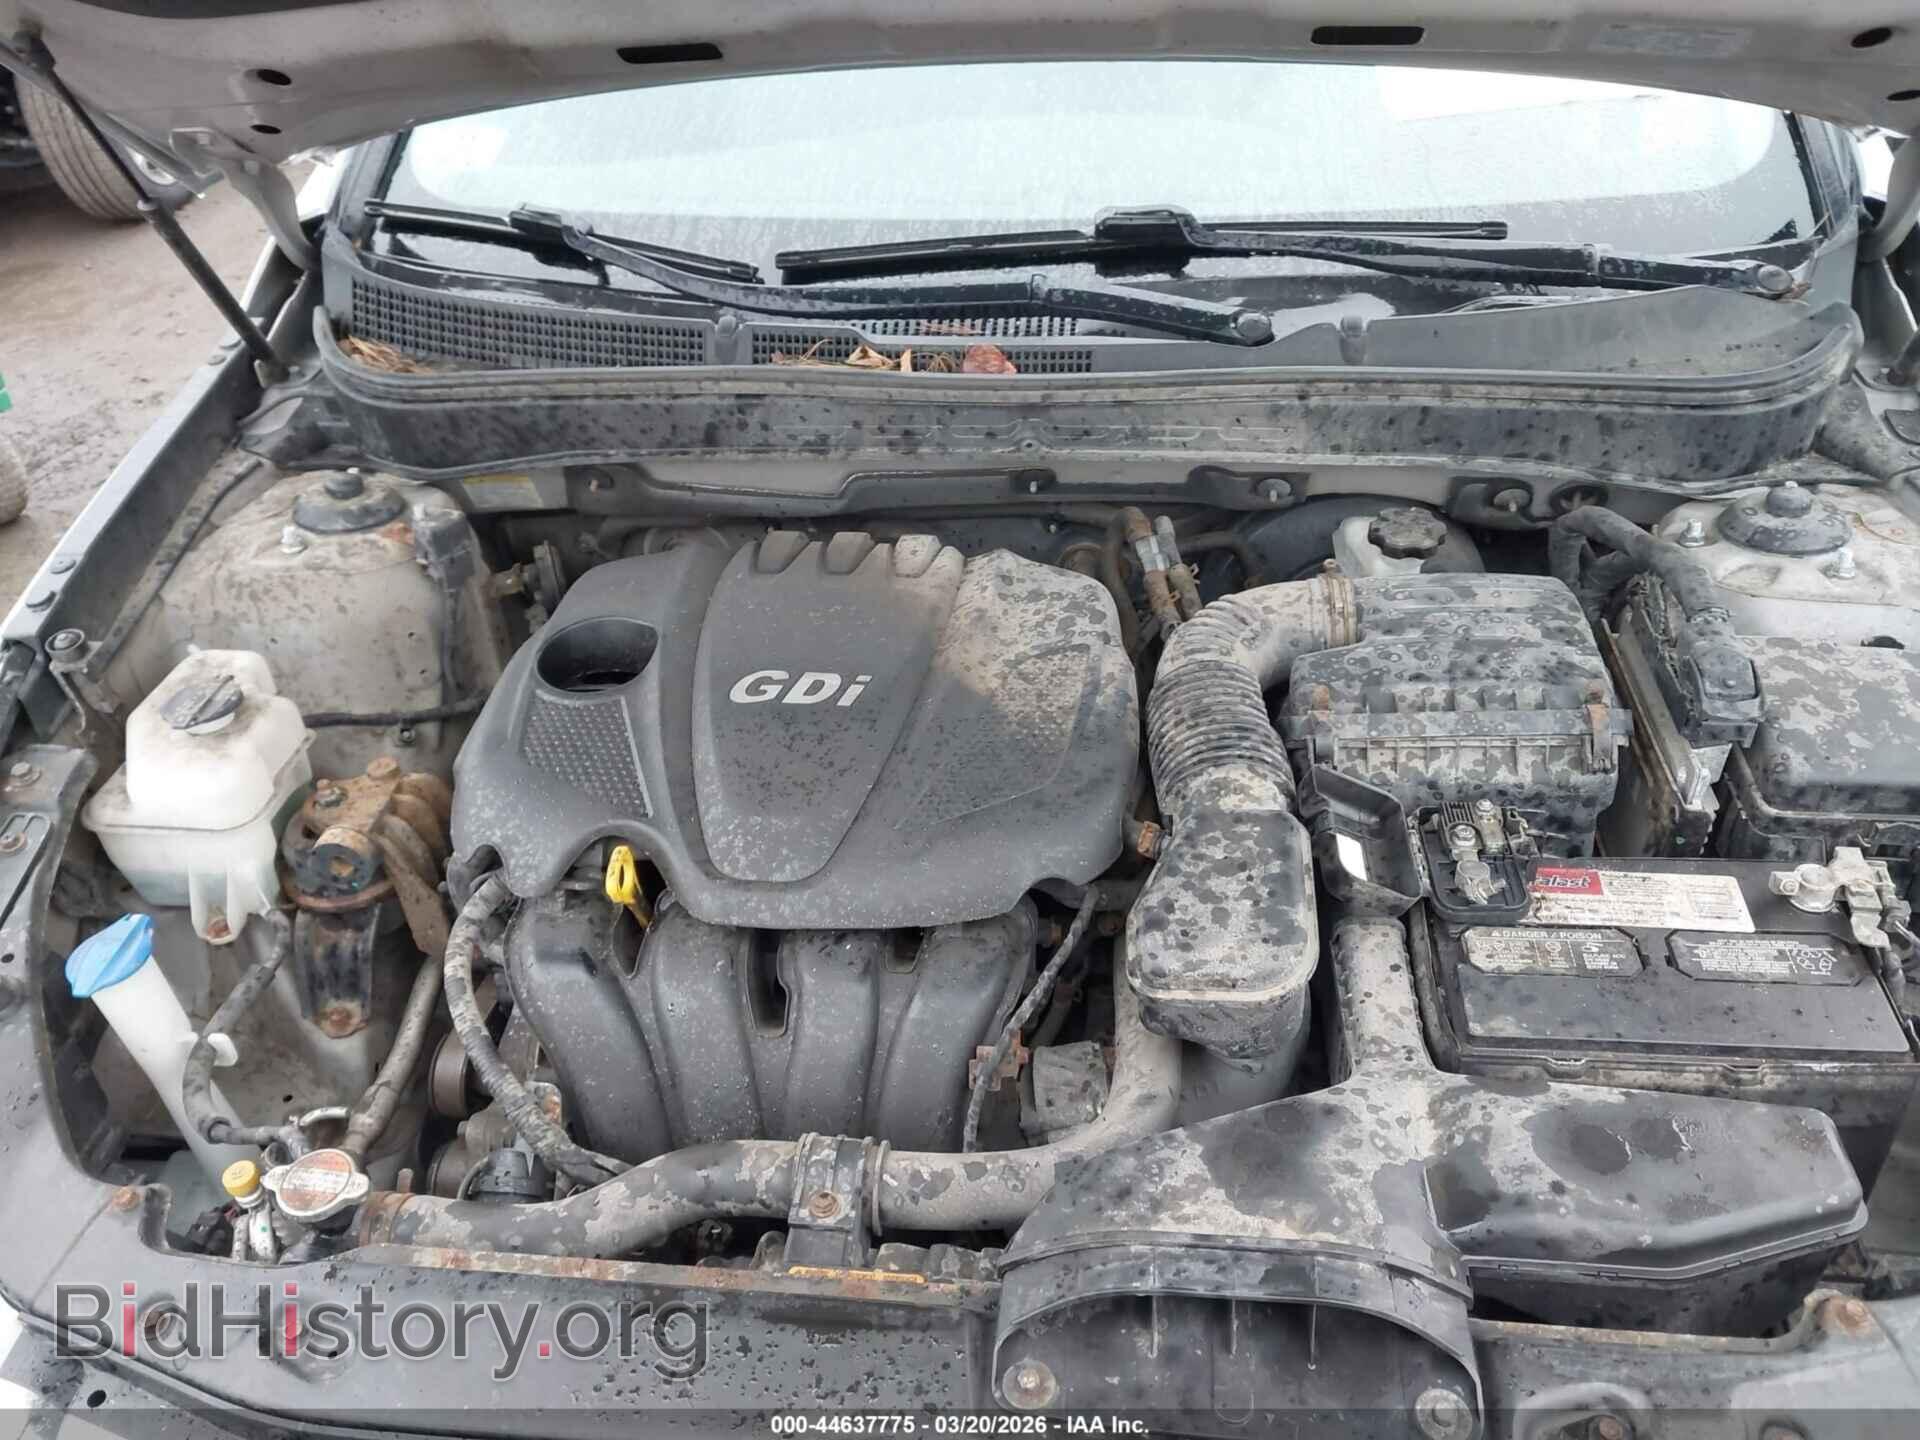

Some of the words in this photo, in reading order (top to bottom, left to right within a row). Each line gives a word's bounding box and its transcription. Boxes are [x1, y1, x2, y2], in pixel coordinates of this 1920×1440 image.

[729, 670, 873, 706] GDi
[1503, 931, 1548, 939] DANGER
[1559, 931, 1602, 940] POISON
